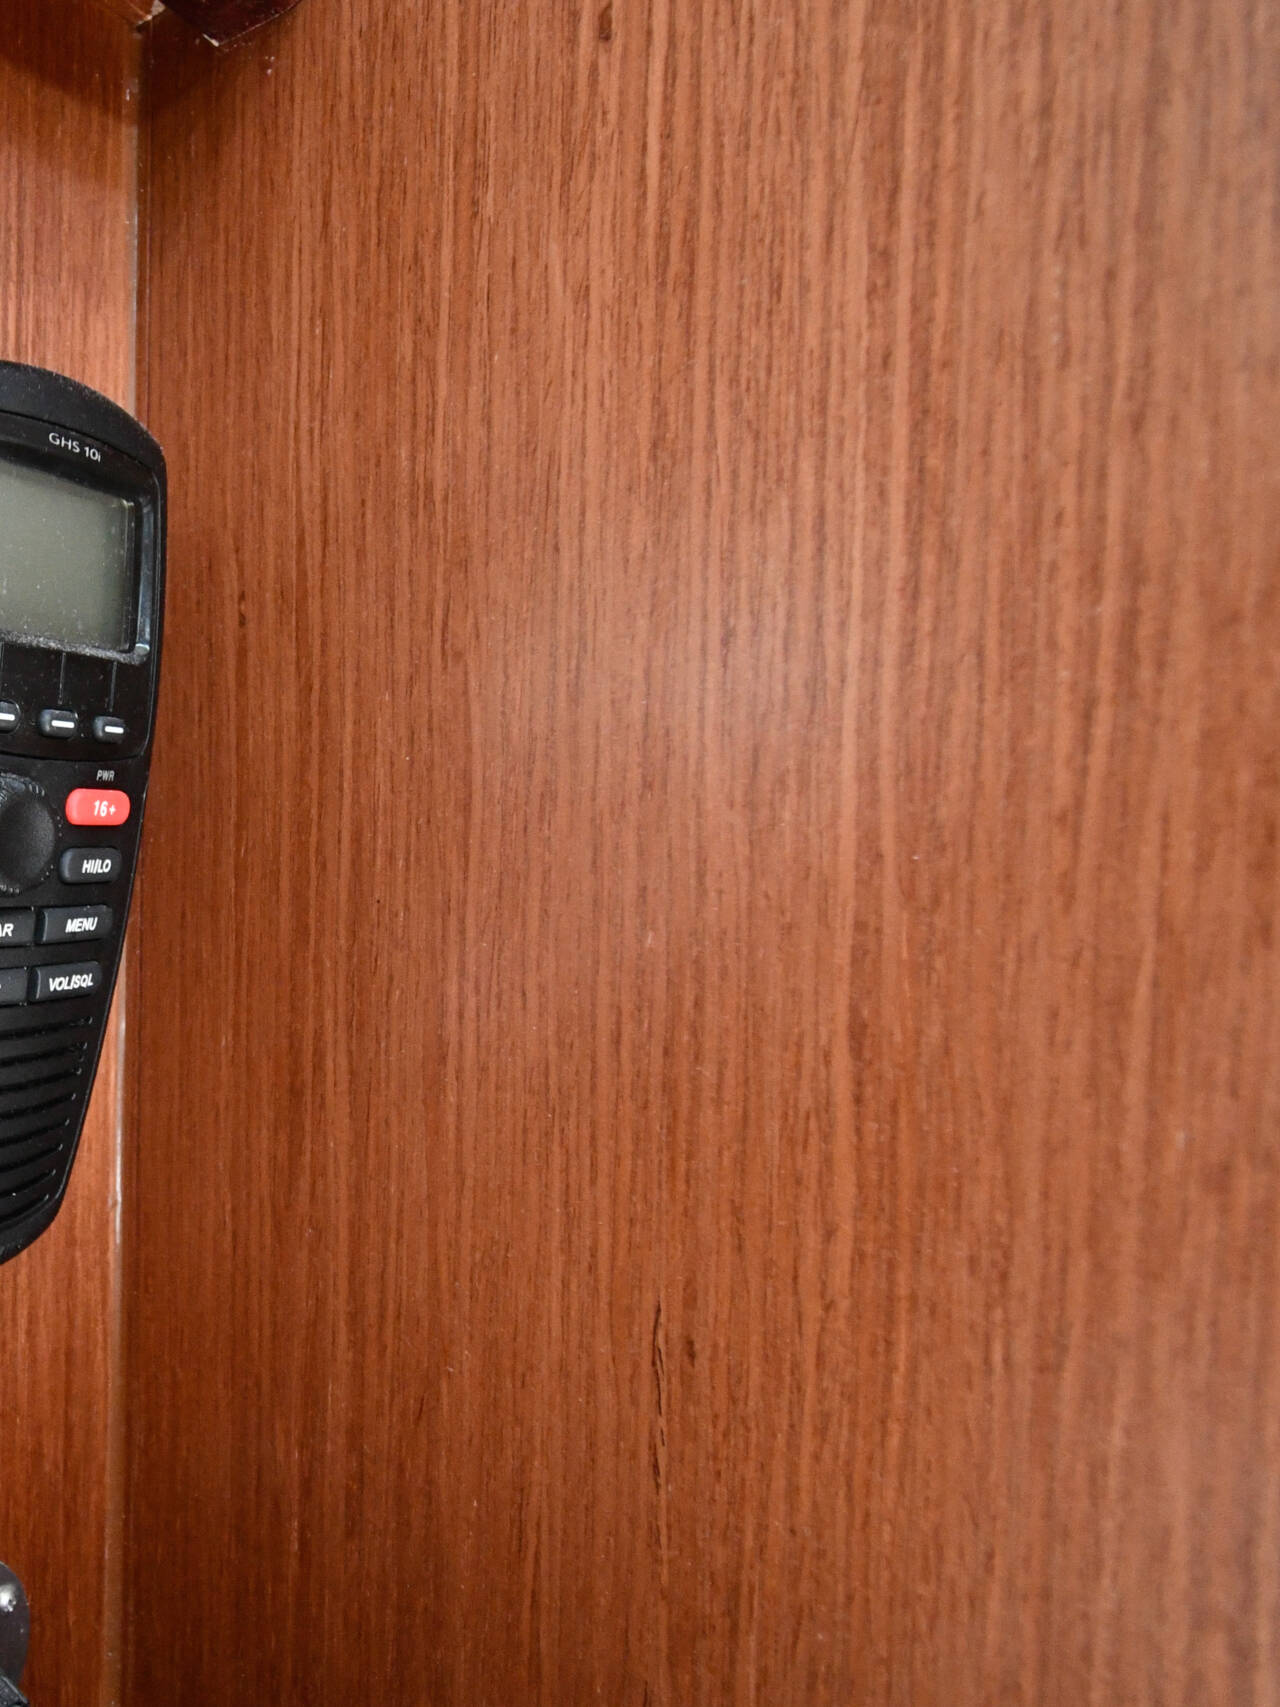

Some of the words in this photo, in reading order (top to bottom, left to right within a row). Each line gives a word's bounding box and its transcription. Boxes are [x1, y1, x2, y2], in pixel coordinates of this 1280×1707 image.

[48, 432, 80, 453] GHS
[96, 770, 115, 782] PWR
[93, 800, 116, 817] 16+
[81, 858, 112, 875] HI/LO
[65, 916, 98, 933] MENU
[48, 973, 94, 993] VOL/SQL
